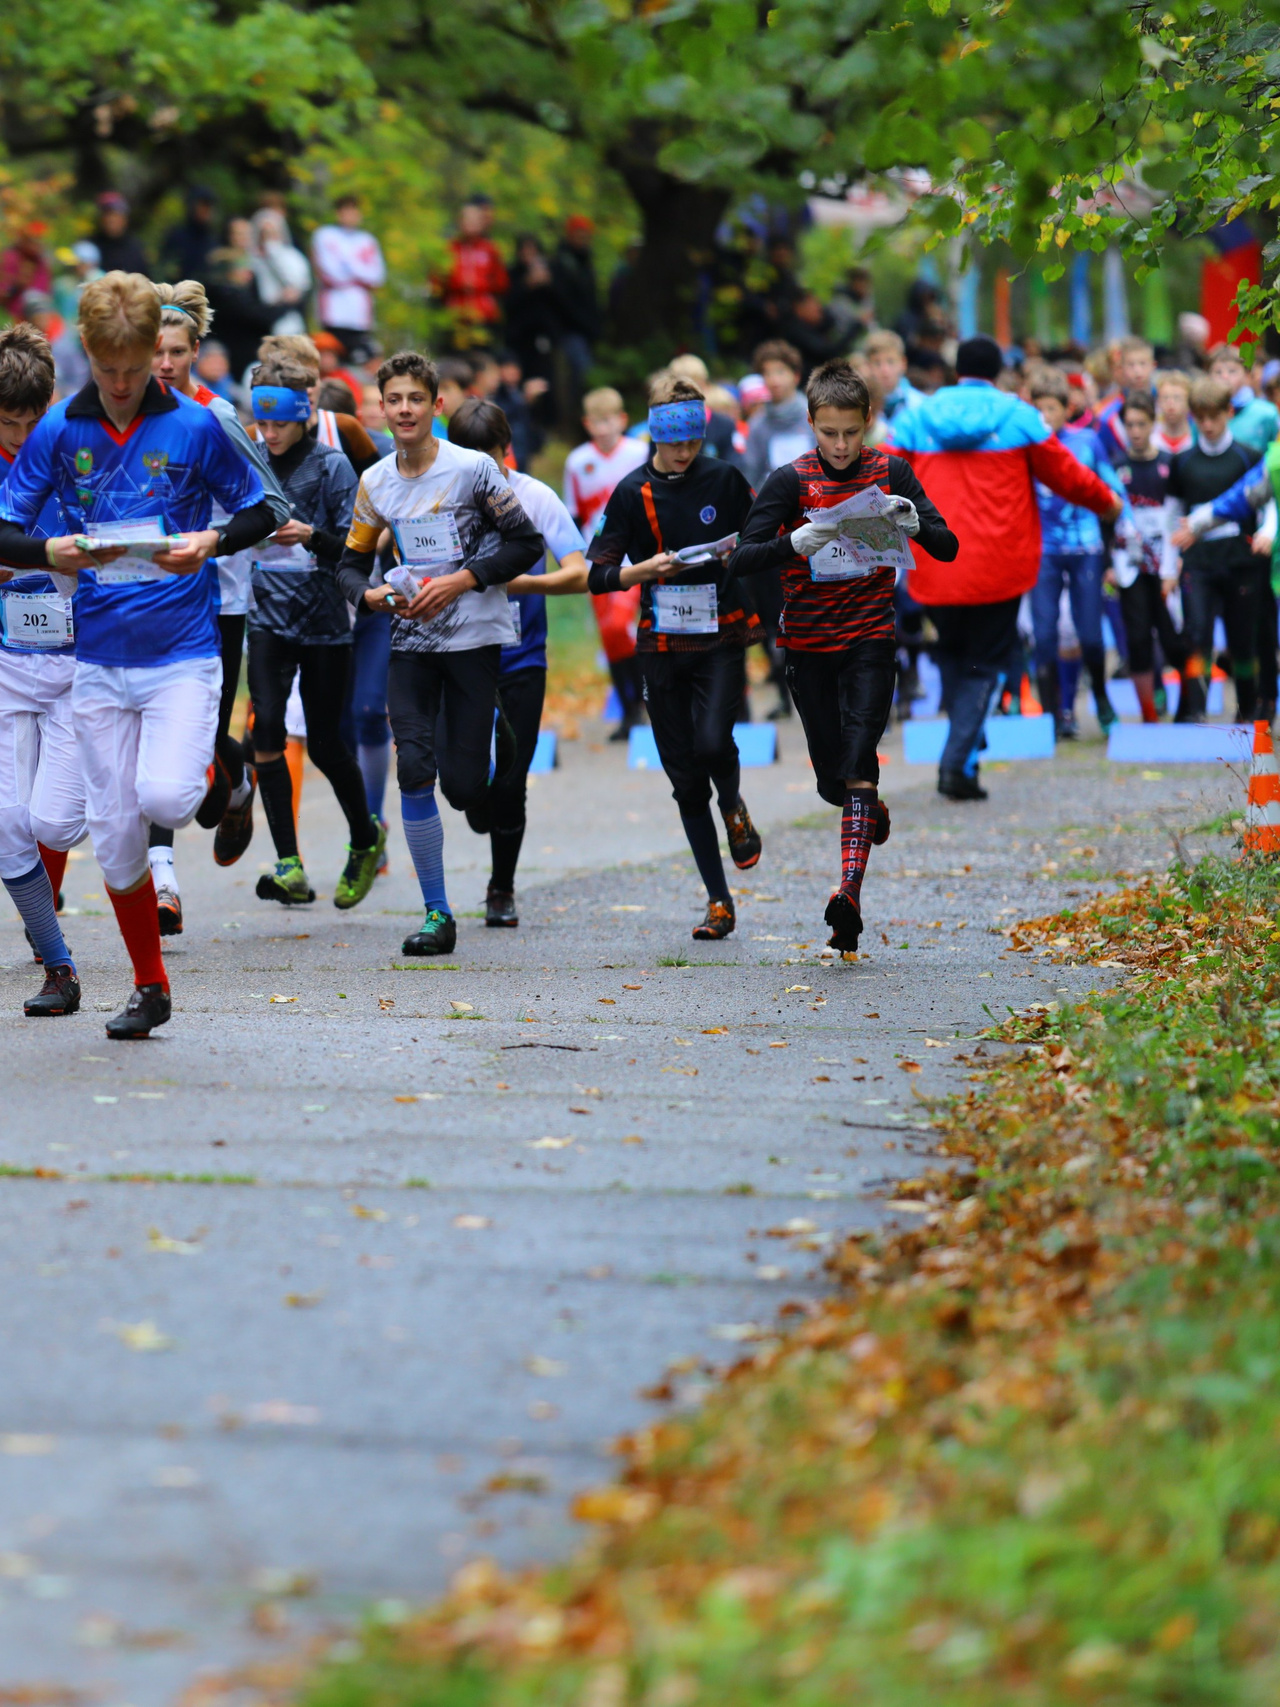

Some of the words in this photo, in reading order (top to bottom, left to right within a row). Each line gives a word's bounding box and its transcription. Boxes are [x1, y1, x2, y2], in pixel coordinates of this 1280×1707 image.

[414, 535, 437, 548] 206
[831, 547, 847, 558] 20
[672, 605, 692, 616] 204
[23, 614, 48, 626] 202
[851, 796, 862, 832] WEST
[856, 805, 870, 872] ORIENTEERING
[846, 838, 859, 881] NORD
